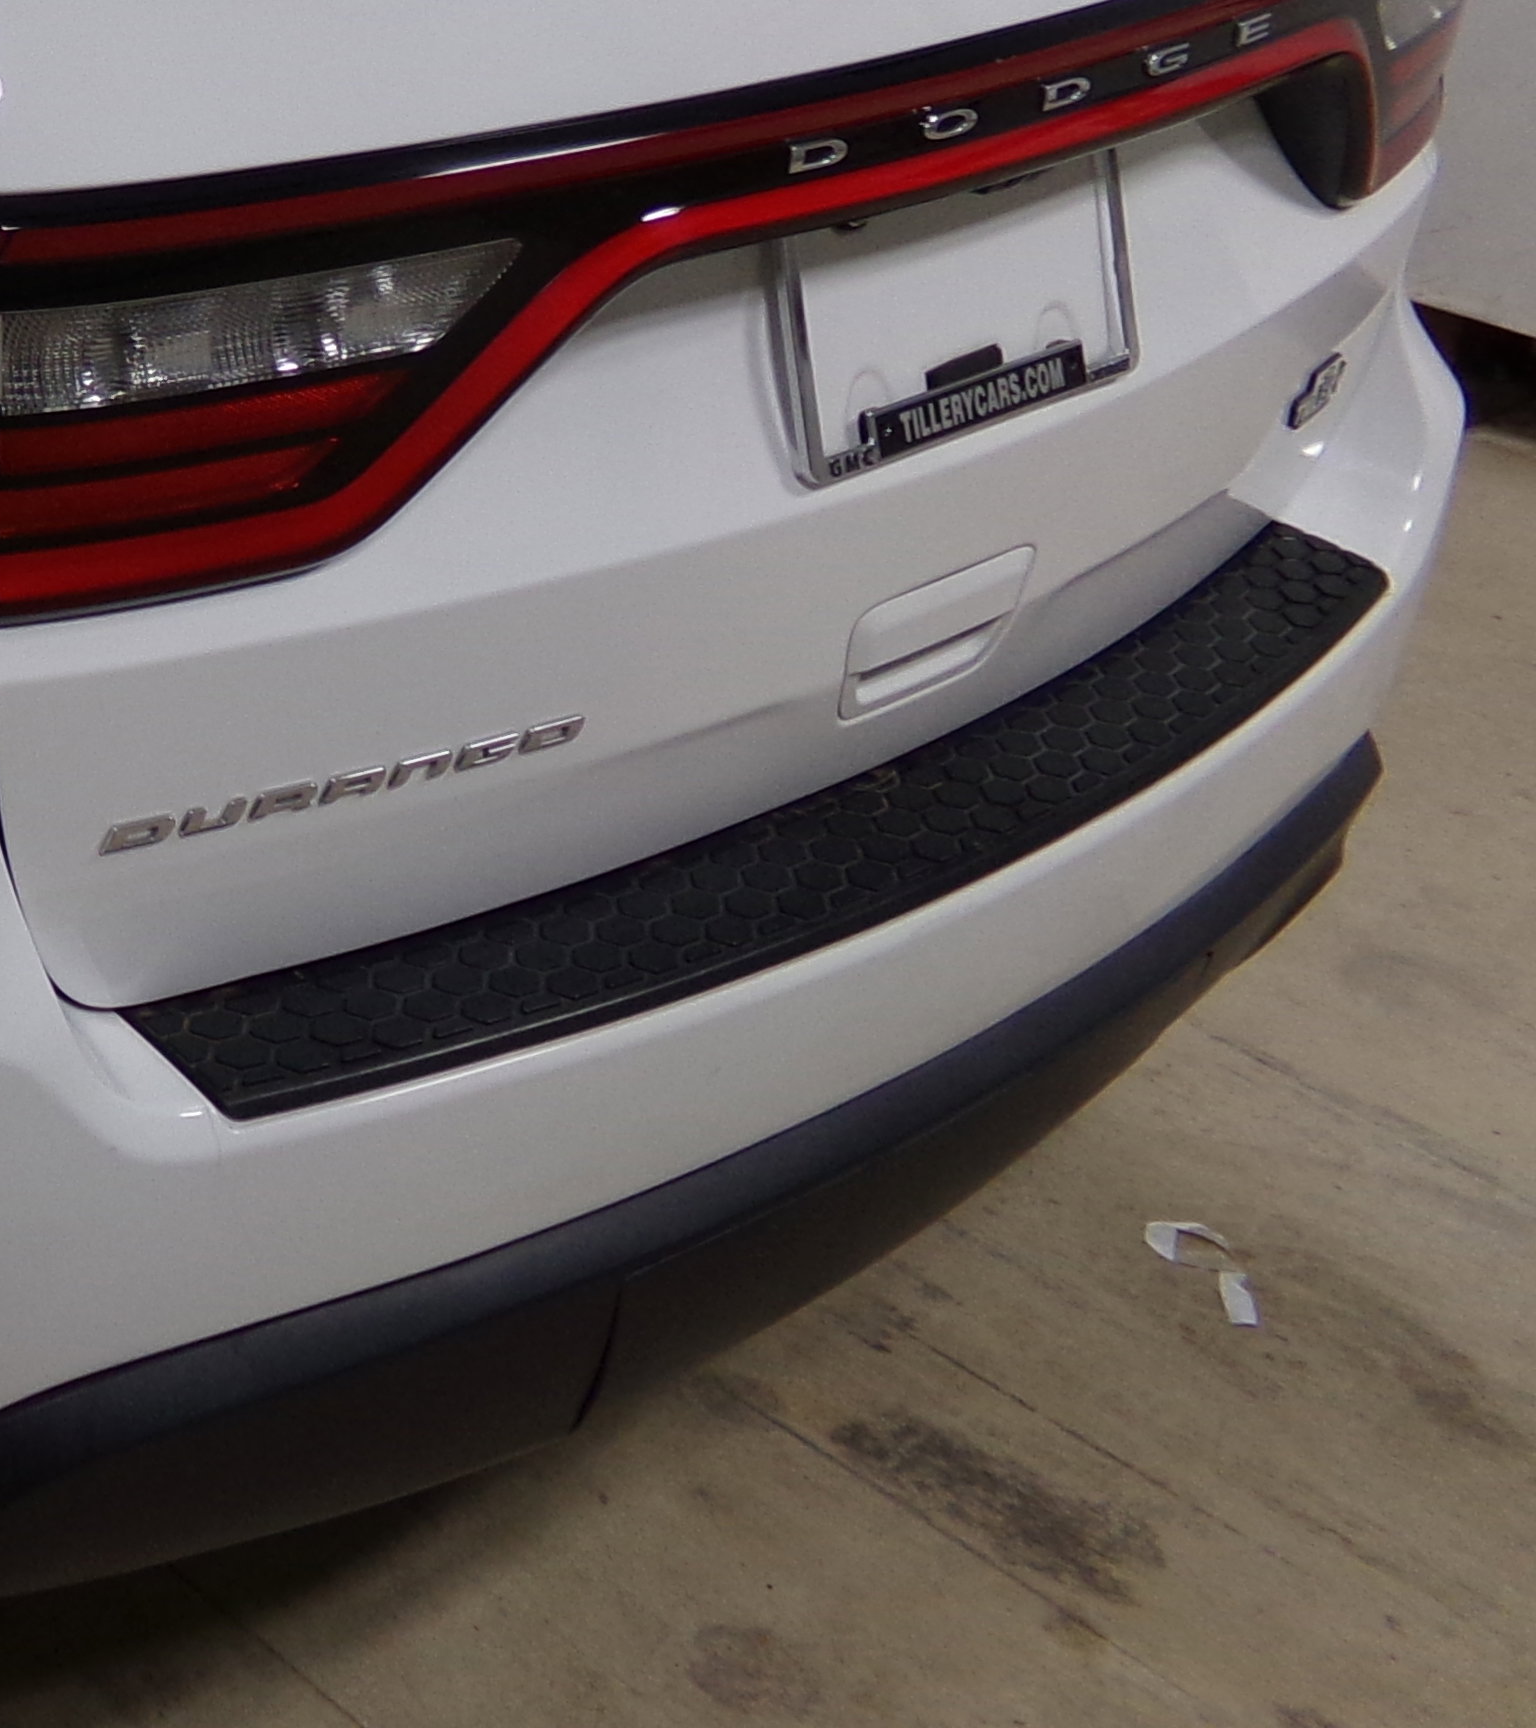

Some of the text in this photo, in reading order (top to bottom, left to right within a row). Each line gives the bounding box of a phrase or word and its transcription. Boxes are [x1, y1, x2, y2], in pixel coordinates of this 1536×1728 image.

[787, 13, 1273, 175] DODGE
[898, 357, 1067, 444] TILLERYCARS.COM
[98, 714, 586, 857] DURANGO
